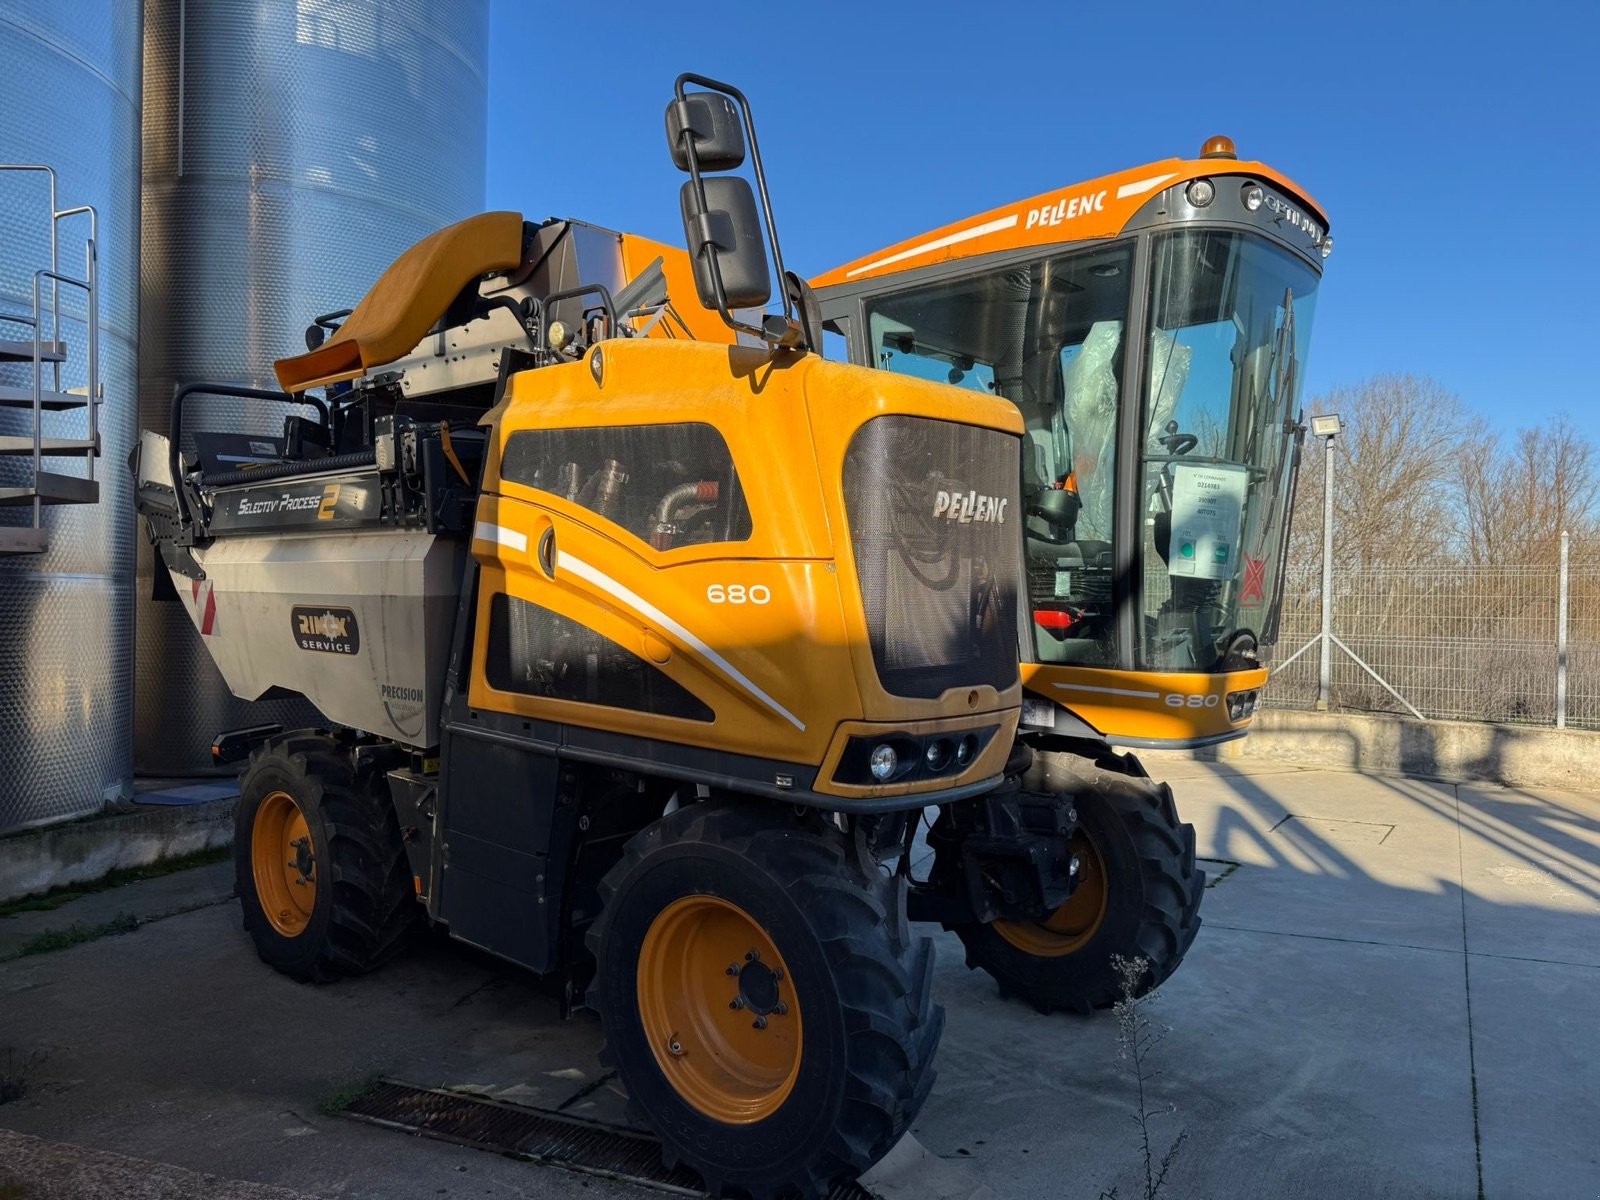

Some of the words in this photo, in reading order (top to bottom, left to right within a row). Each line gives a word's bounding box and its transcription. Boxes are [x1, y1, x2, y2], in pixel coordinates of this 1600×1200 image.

[1025, 190, 1107, 230] PELLENC
[279, 493, 321, 512] PROCESS
[317, 484, 341, 520] 2
[932, 490, 1008, 524] PELLENC
[707, 584, 771, 605] 680
[302, 640, 351, 653] SERVICE
[381, 684, 423, 702] PRECISION
[1165, 693, 1219, 708] 680
